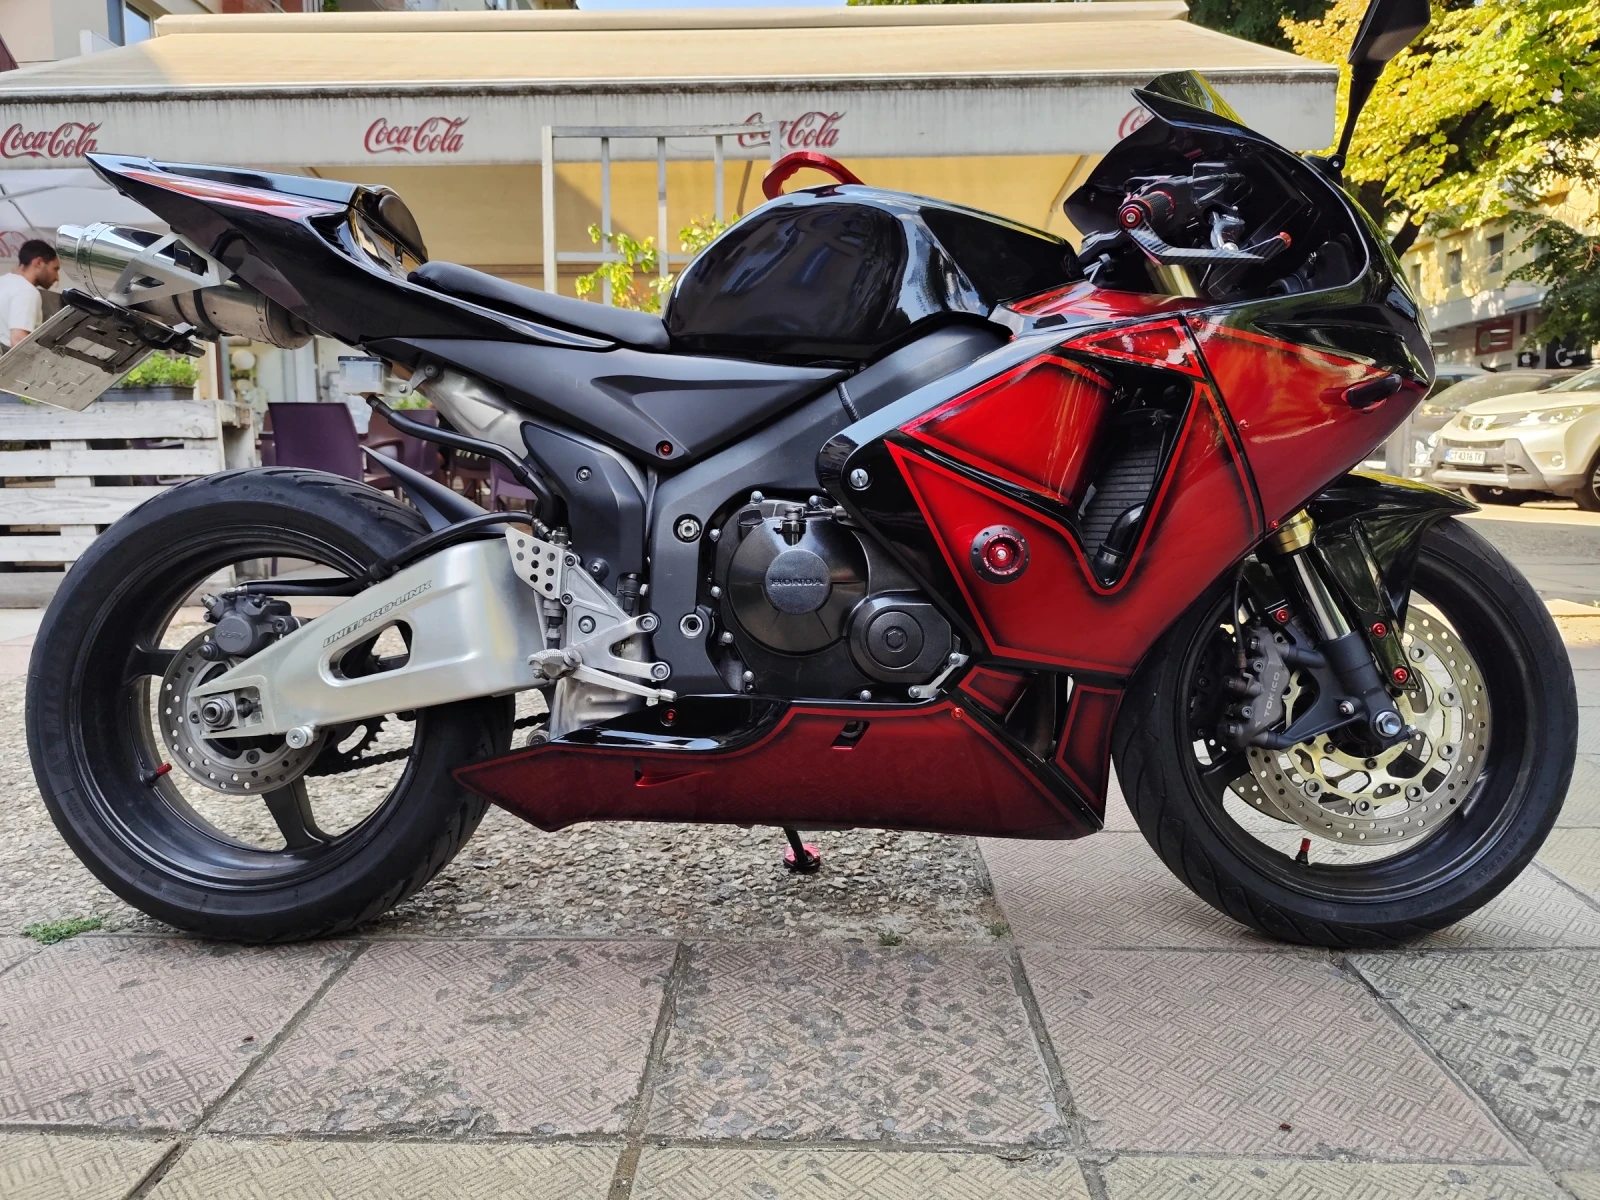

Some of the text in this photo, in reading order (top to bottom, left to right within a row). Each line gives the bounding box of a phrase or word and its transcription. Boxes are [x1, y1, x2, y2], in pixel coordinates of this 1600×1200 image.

[0, 121, 103, 159] Coca-Cola
[364, 116, 470, 155] Coca-Cola
[770, 578, 825, 586] HONDA
[323, 580, 432, 648] UNIT PRO-LINK
[1264, 672, 1280, 717] TOKICO
